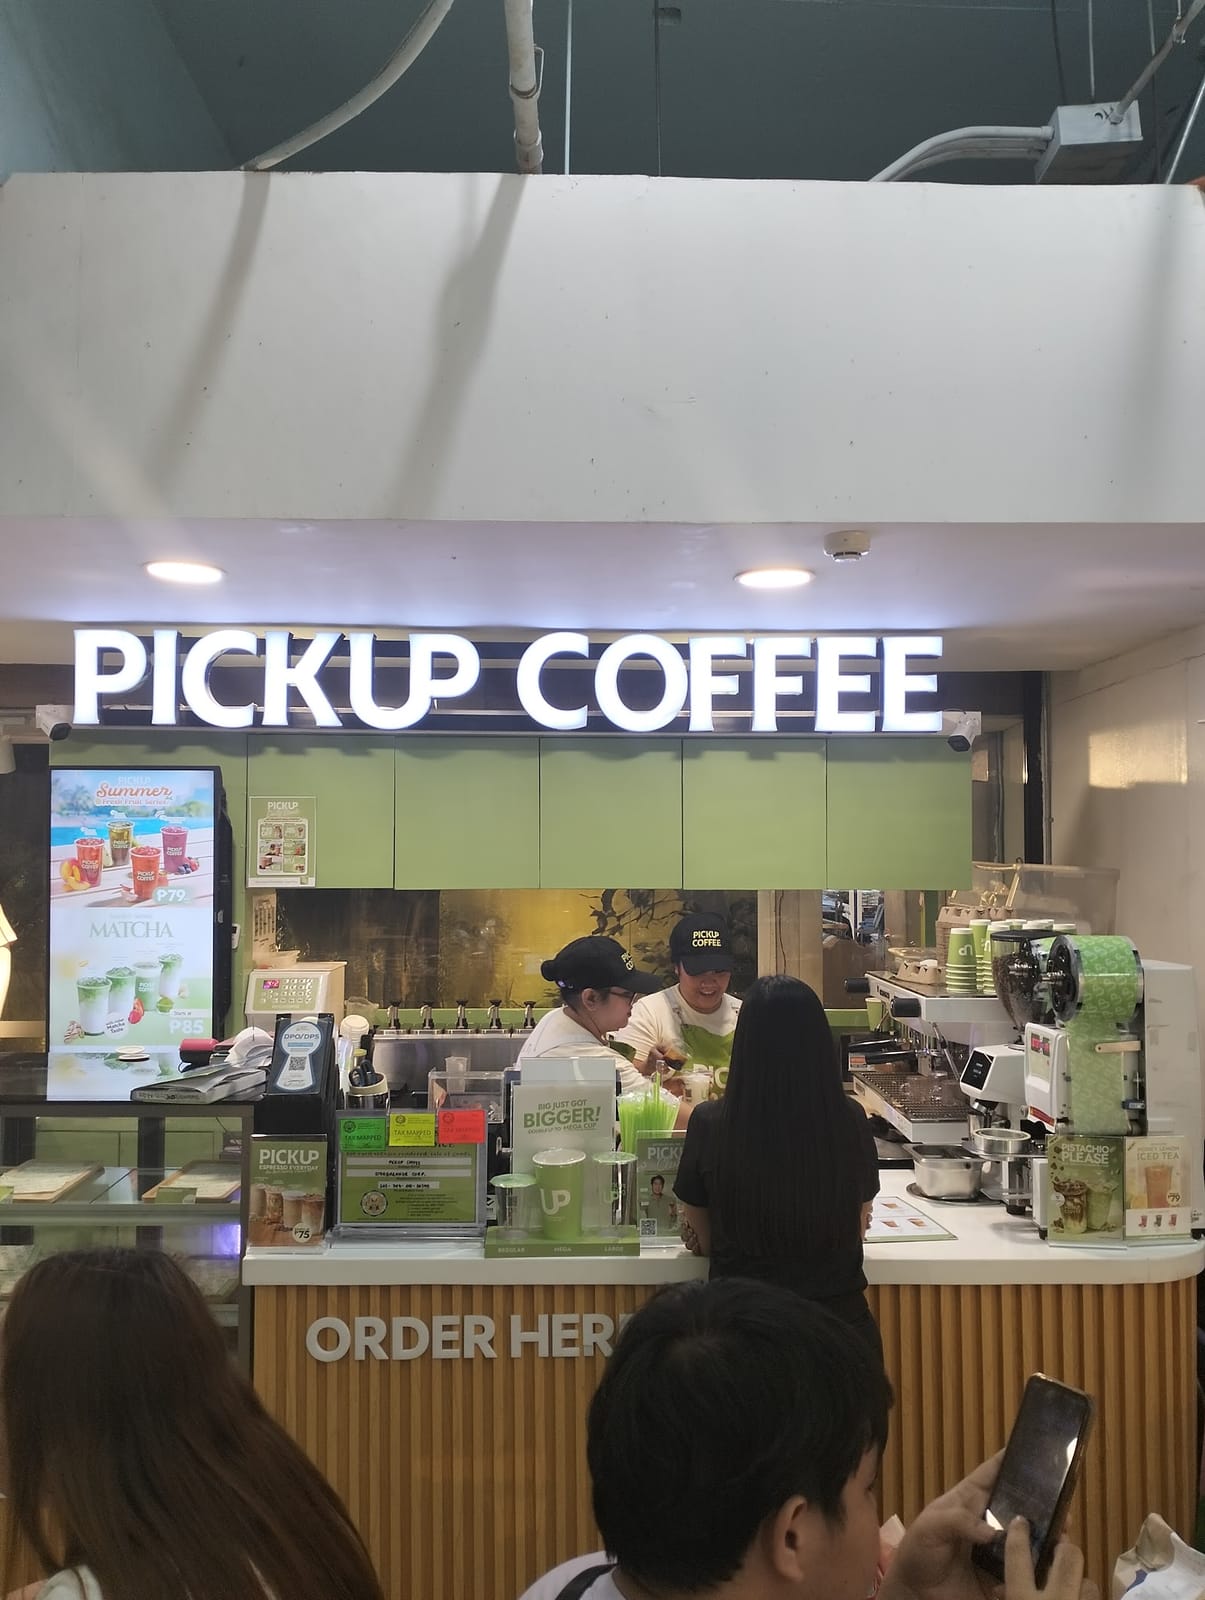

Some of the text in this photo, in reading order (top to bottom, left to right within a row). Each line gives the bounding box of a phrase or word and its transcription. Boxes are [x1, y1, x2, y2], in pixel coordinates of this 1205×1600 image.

[73, 629, 941, 731] PICKUP COFFEE
[96, 782, 173, 798] Summer
[268, 801, 298, 810] PICKUP
[89, 921, 174, 938] MATCHA
[692, 930, 720, 939] PICKUP
[691, 938, 721, 947] COFFEE
[538, 1099, 588, 1111] BIG JUST GOT
[523, 1106, 601, 1128] BIGGER!
[1061, 1143, 1110, 1154] PISTACHIO
[259, 1149, 320, 1165] PICKUP
[1061, 1152, 1110, 1164] PLEASE
[1137, 1151, 1180, 1161] ICED TEA
[540, 1188, 571, 1216] UP
[306, 1313, 630, 1362] ORDER HER
